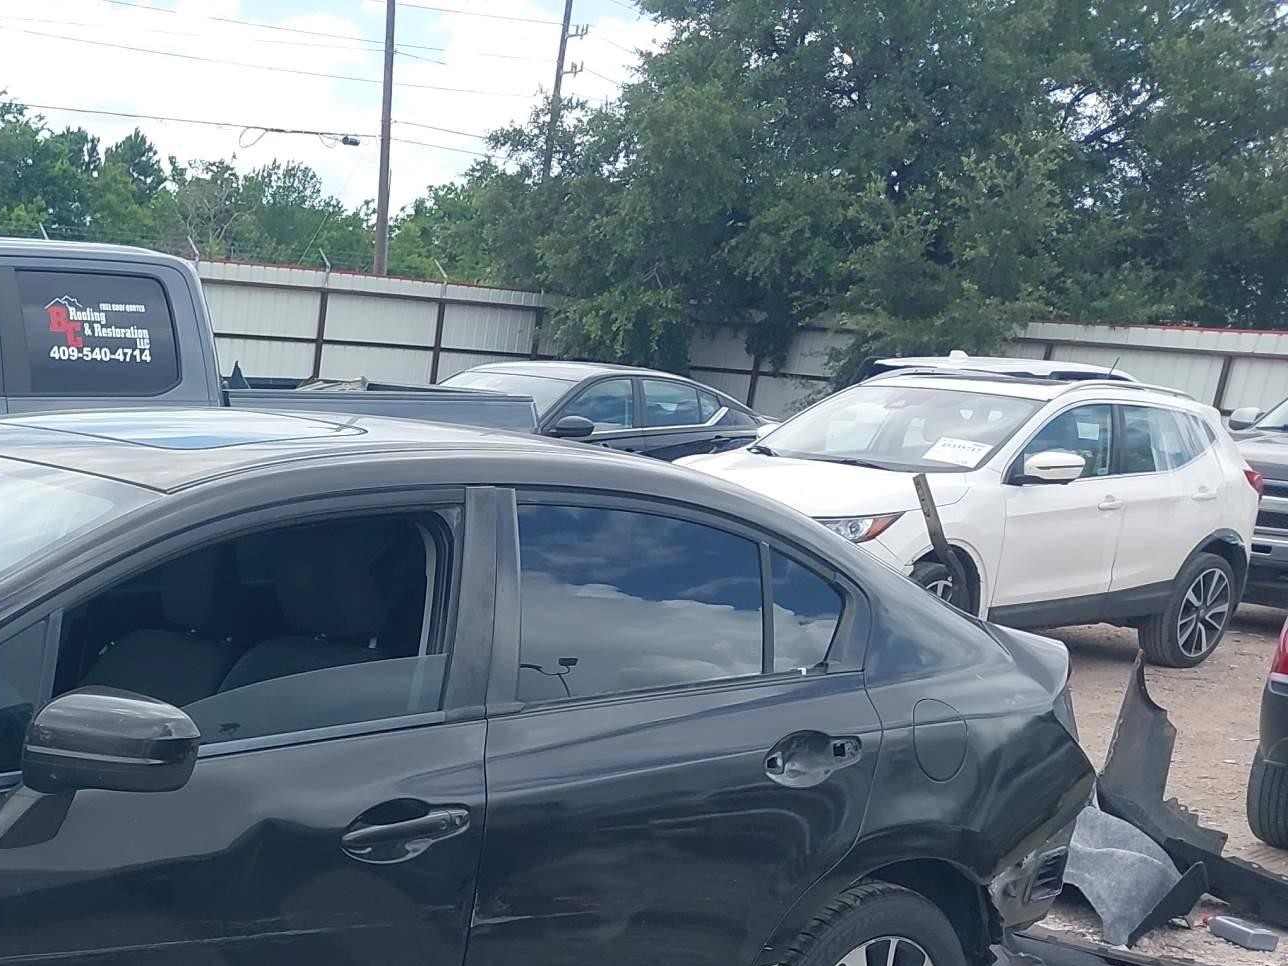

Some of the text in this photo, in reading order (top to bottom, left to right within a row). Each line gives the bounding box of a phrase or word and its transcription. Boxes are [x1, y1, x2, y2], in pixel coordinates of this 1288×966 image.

[69, 306, 106, 325] Roofing
[84, 322, 149, 339] & Restoration
[136, 338, 151, 349] LLC
[50, 345, 152, 363] 409-540-4714
